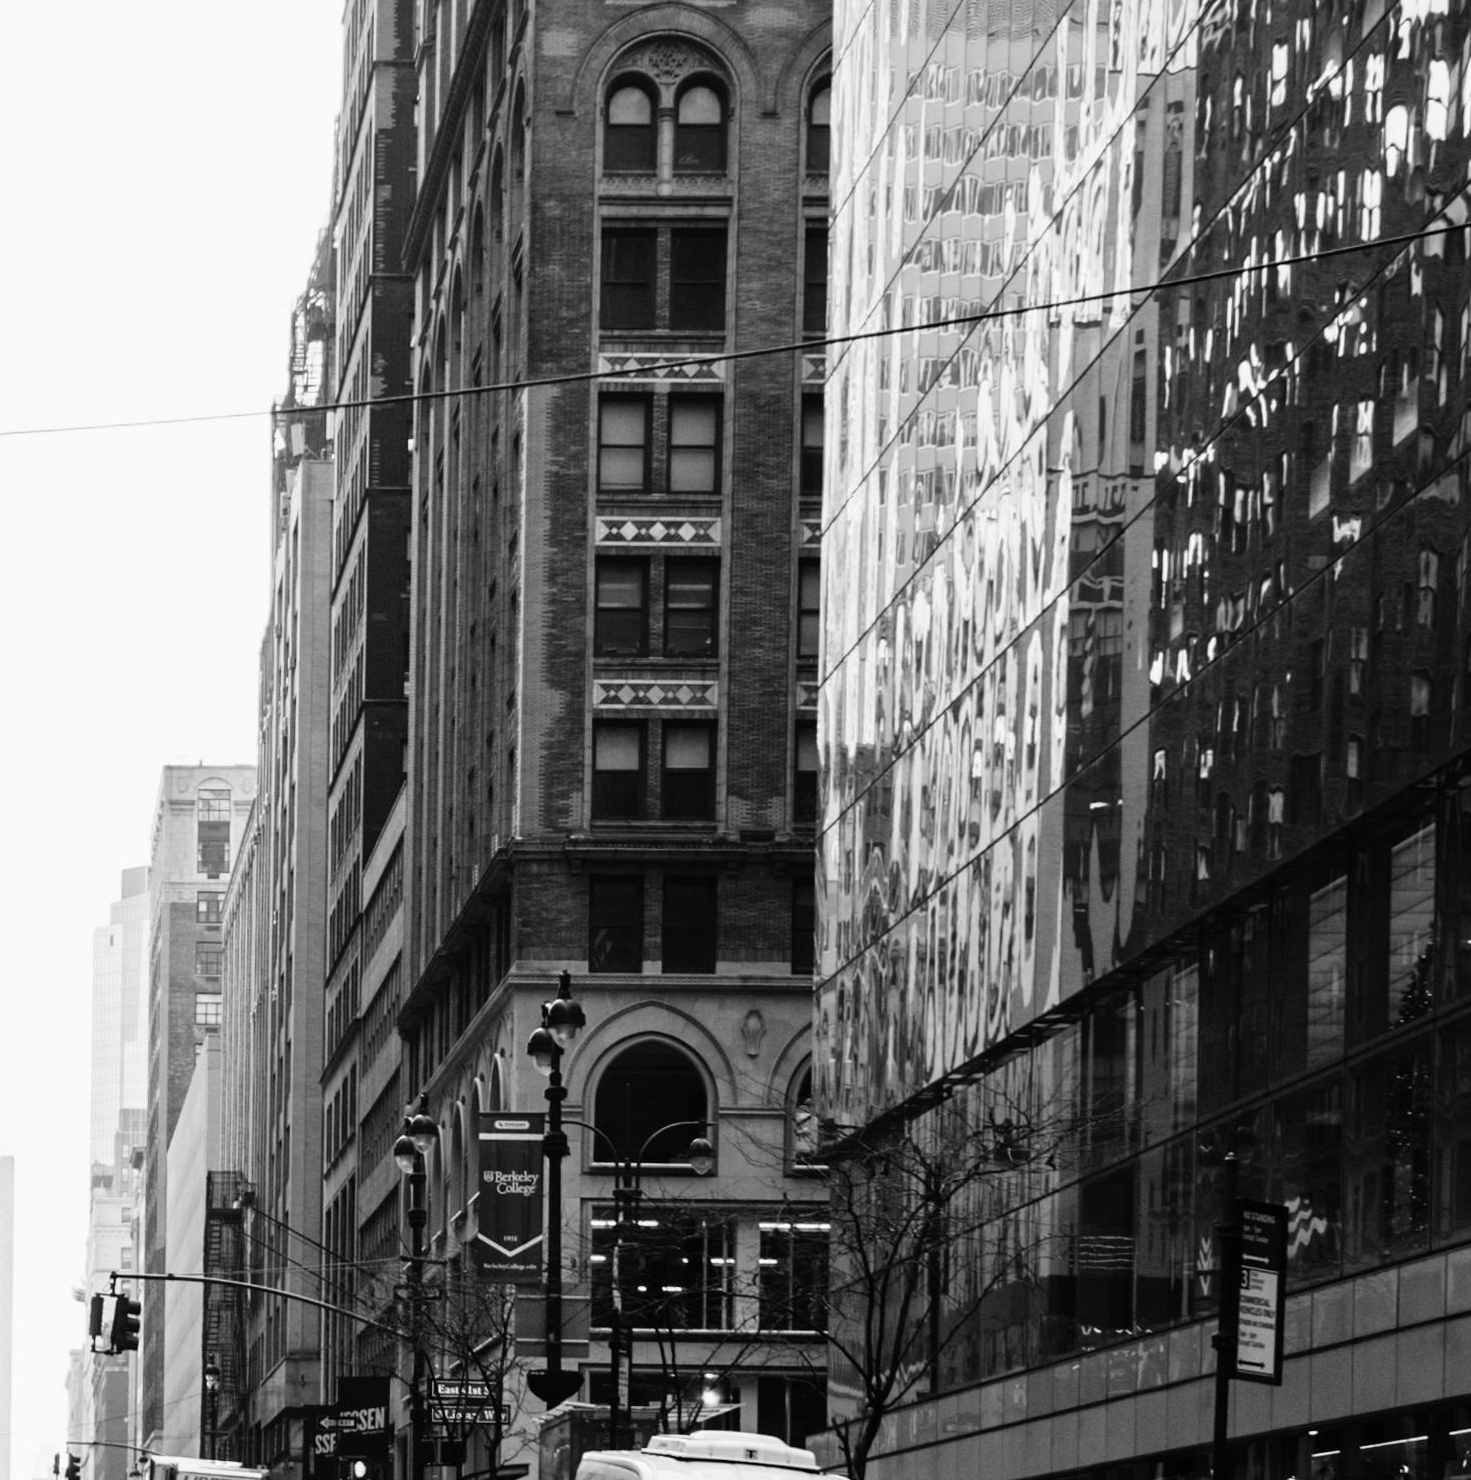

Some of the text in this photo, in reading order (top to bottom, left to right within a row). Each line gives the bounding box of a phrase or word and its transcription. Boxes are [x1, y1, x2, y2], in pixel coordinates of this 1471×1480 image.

[495, 1170, 539, 1186] Berkeley
[496, 1182, 537, 1197] College
[1240, 1268, 1249, 1288] 3
[437, 1383, 460, 1395] East
